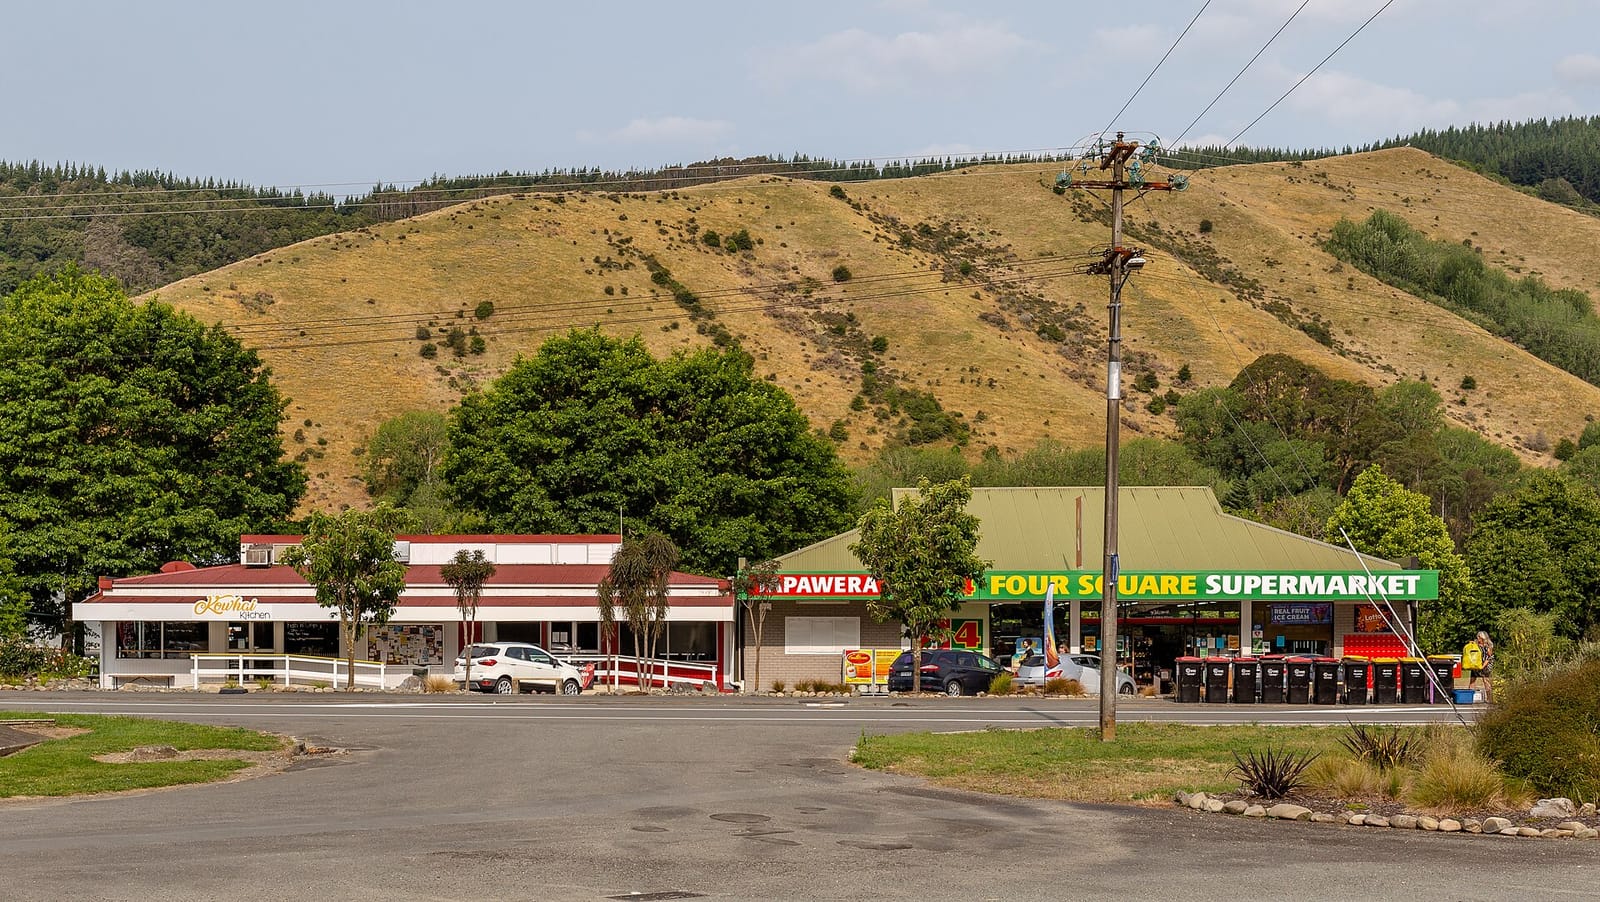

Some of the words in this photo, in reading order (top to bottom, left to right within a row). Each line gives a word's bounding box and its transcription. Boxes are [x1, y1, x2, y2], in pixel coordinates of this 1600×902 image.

[754, 576, 878, 593] PAWERA
[990, 575, 1070, 595] FOUR
[1205, 575, 1421, 595] SUPERMARKET
[194, 594, 257, 615] Kowhai
[953, 621, 981, 648] 4
